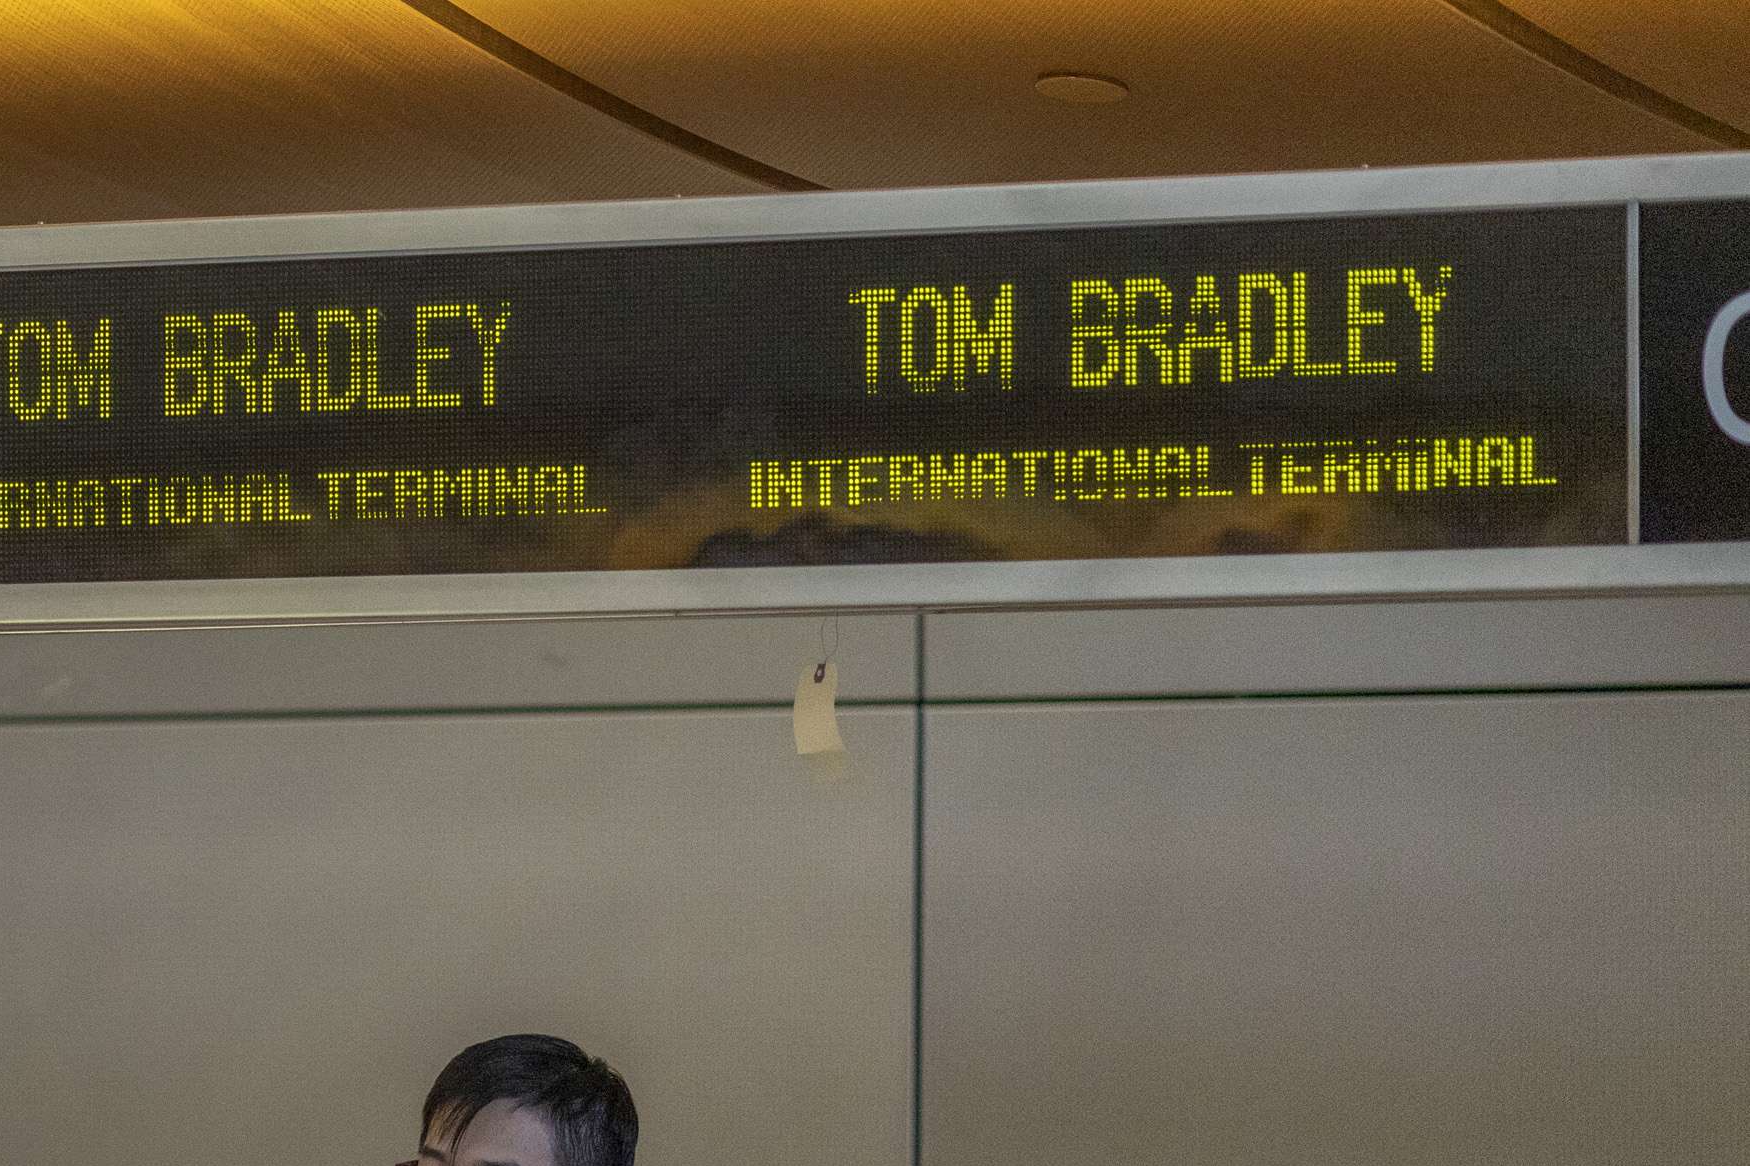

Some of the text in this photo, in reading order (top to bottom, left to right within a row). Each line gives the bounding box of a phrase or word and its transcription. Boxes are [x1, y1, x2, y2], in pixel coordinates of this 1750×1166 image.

[162, 300, 514, 418] BRADLEY
[849, 265, 1454, 392] TOM BRADLEY
[317, 464, 609, 524] TERMINAL
[750, 435, 1559, 510] INTERNATIONAL TERMINAL
